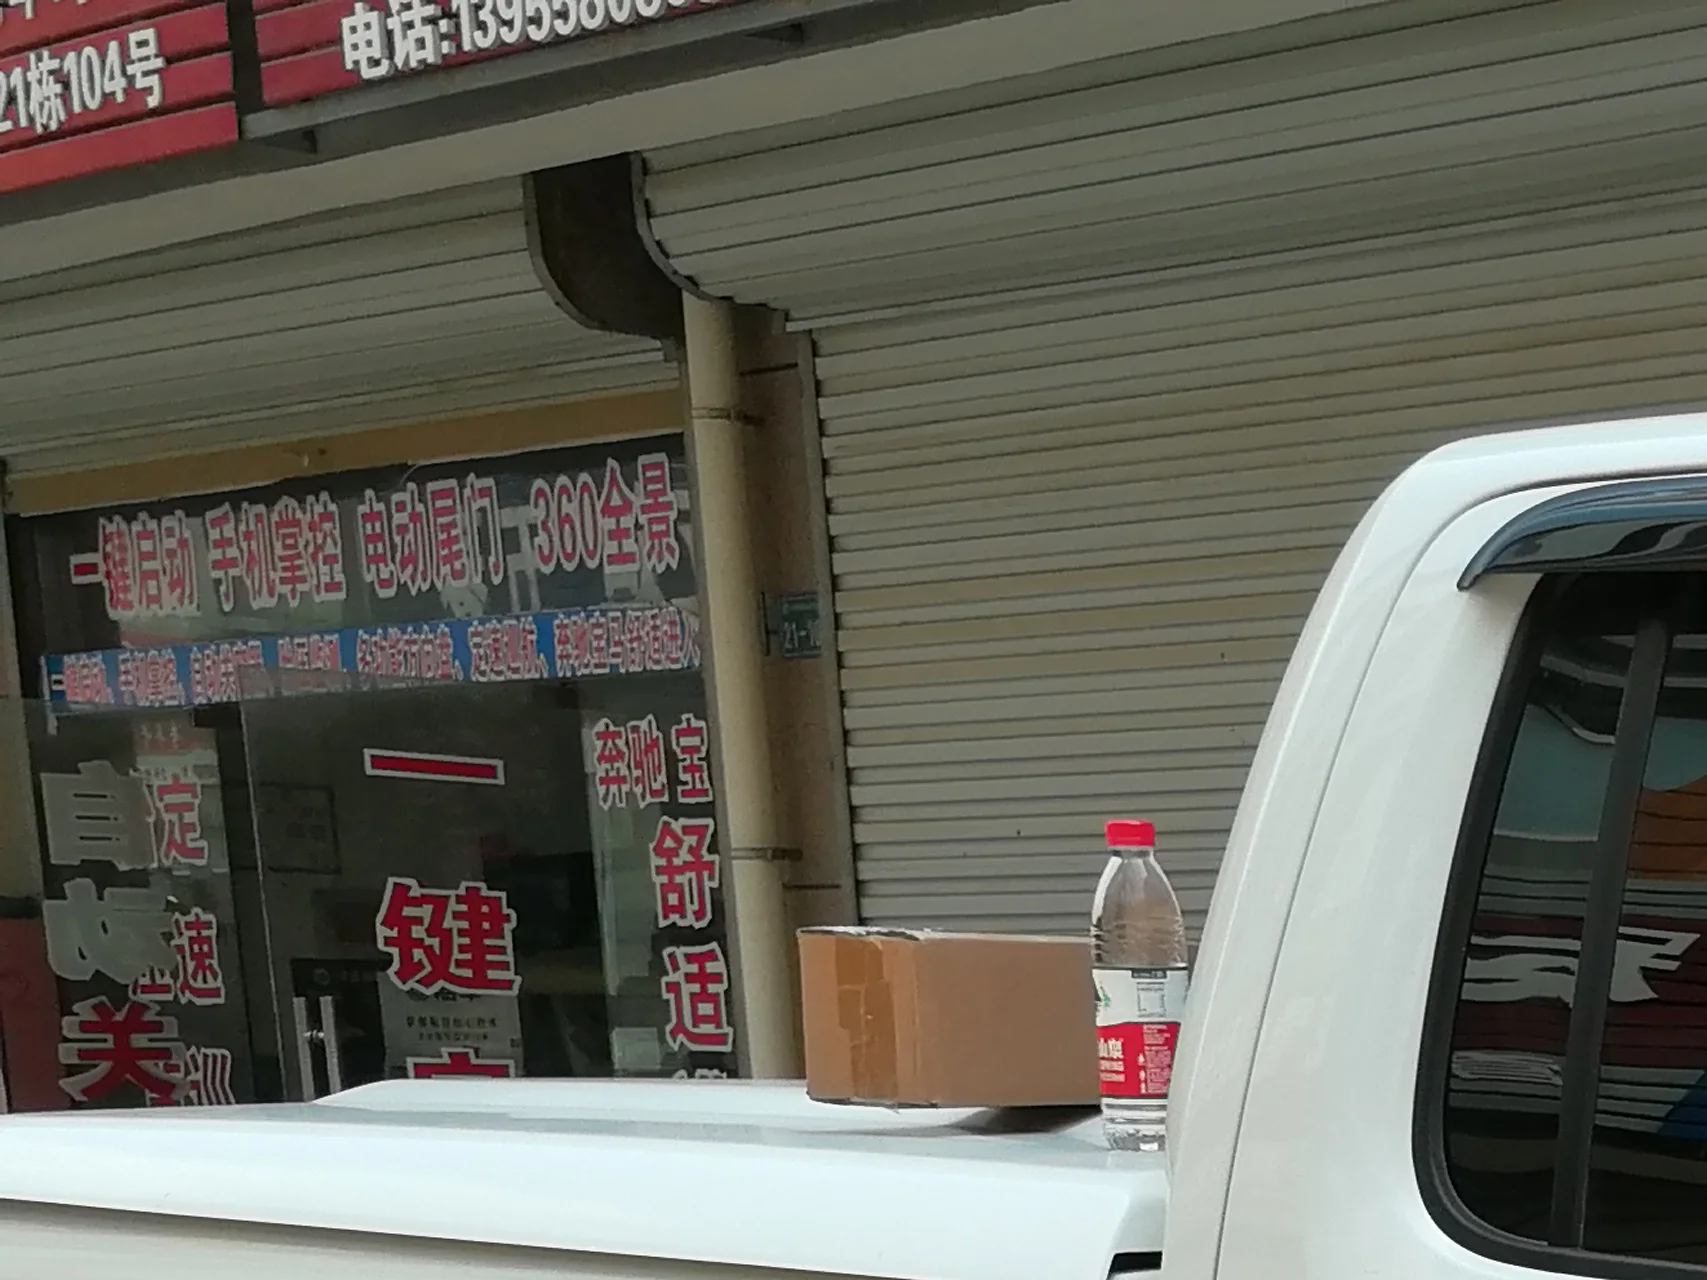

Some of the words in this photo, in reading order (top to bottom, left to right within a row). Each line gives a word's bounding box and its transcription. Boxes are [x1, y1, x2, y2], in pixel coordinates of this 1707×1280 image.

[70, 508, 200, 621] 一键启动
[205, 492, 345, 611] 手机掌控
[358, 473, 502, 599] 电动尾门
[529, 452, 682, 575] 360全景
